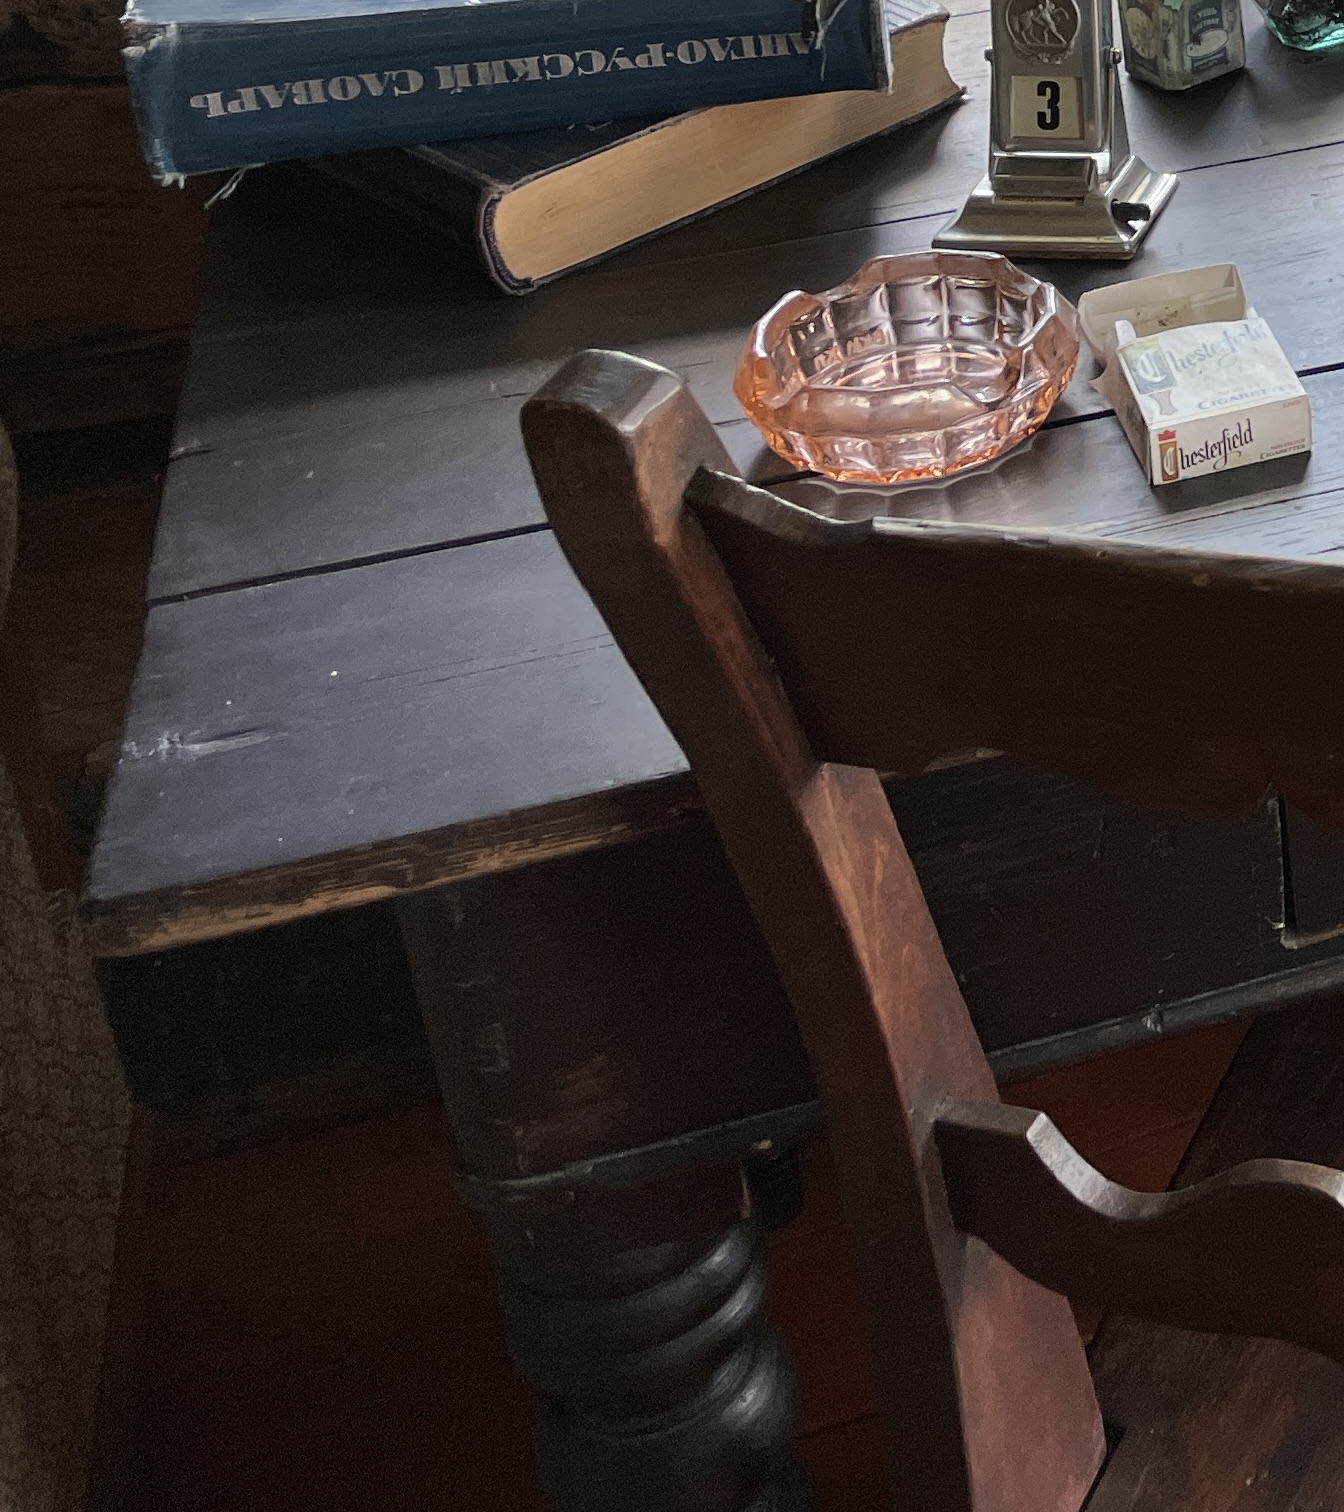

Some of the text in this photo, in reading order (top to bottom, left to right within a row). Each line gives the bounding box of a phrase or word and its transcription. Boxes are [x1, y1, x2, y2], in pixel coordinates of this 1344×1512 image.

[189, 31, 817, 119] АНГЛО-РУССКИЙ СЛОВАРЬ
[1037, 80, 1060, 131] 3
[1163, 417, 1255, 476] Chesterfield
